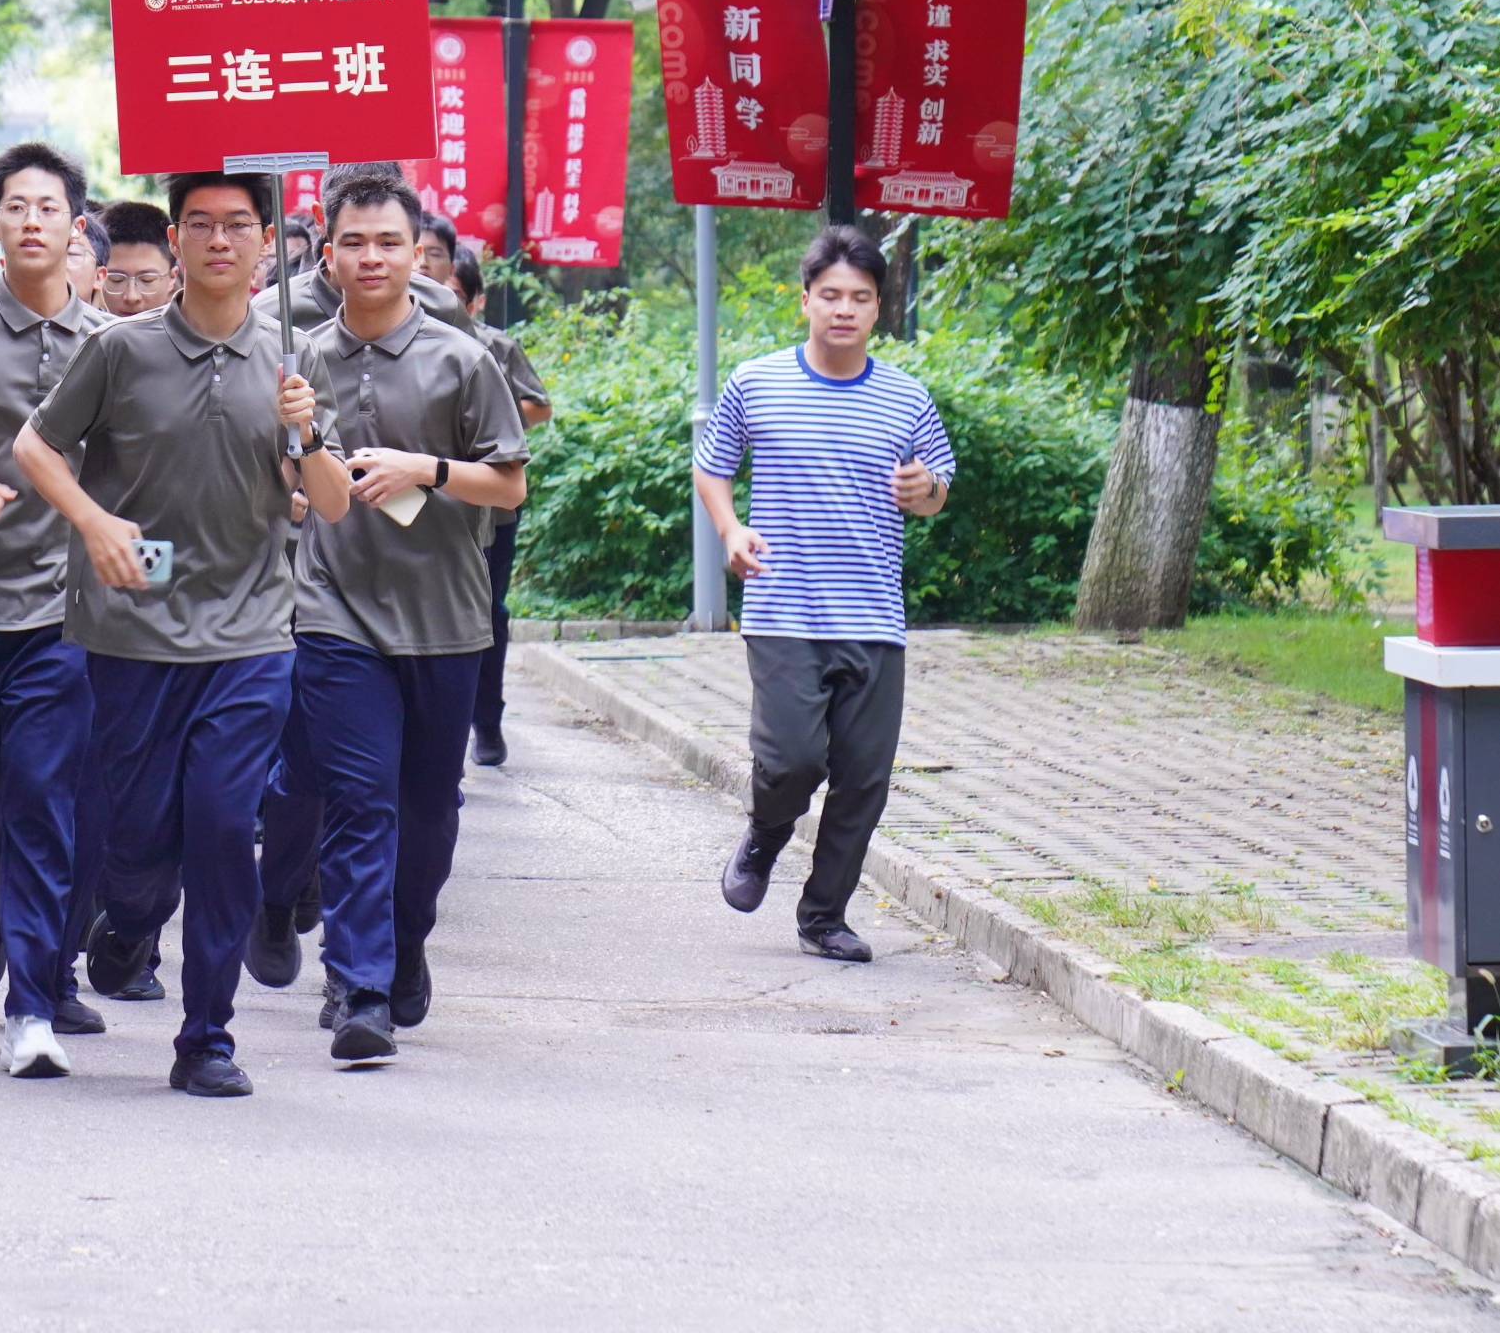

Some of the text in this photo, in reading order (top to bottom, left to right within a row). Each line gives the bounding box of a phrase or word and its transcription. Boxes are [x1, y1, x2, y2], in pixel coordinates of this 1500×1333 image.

[166, 42, 389, 102] 三连二班
[923, 39, 949, 87] 求实
[916, 98, 944, 146] 创新
[440, 85, 468, 218] 欢迎新同学
